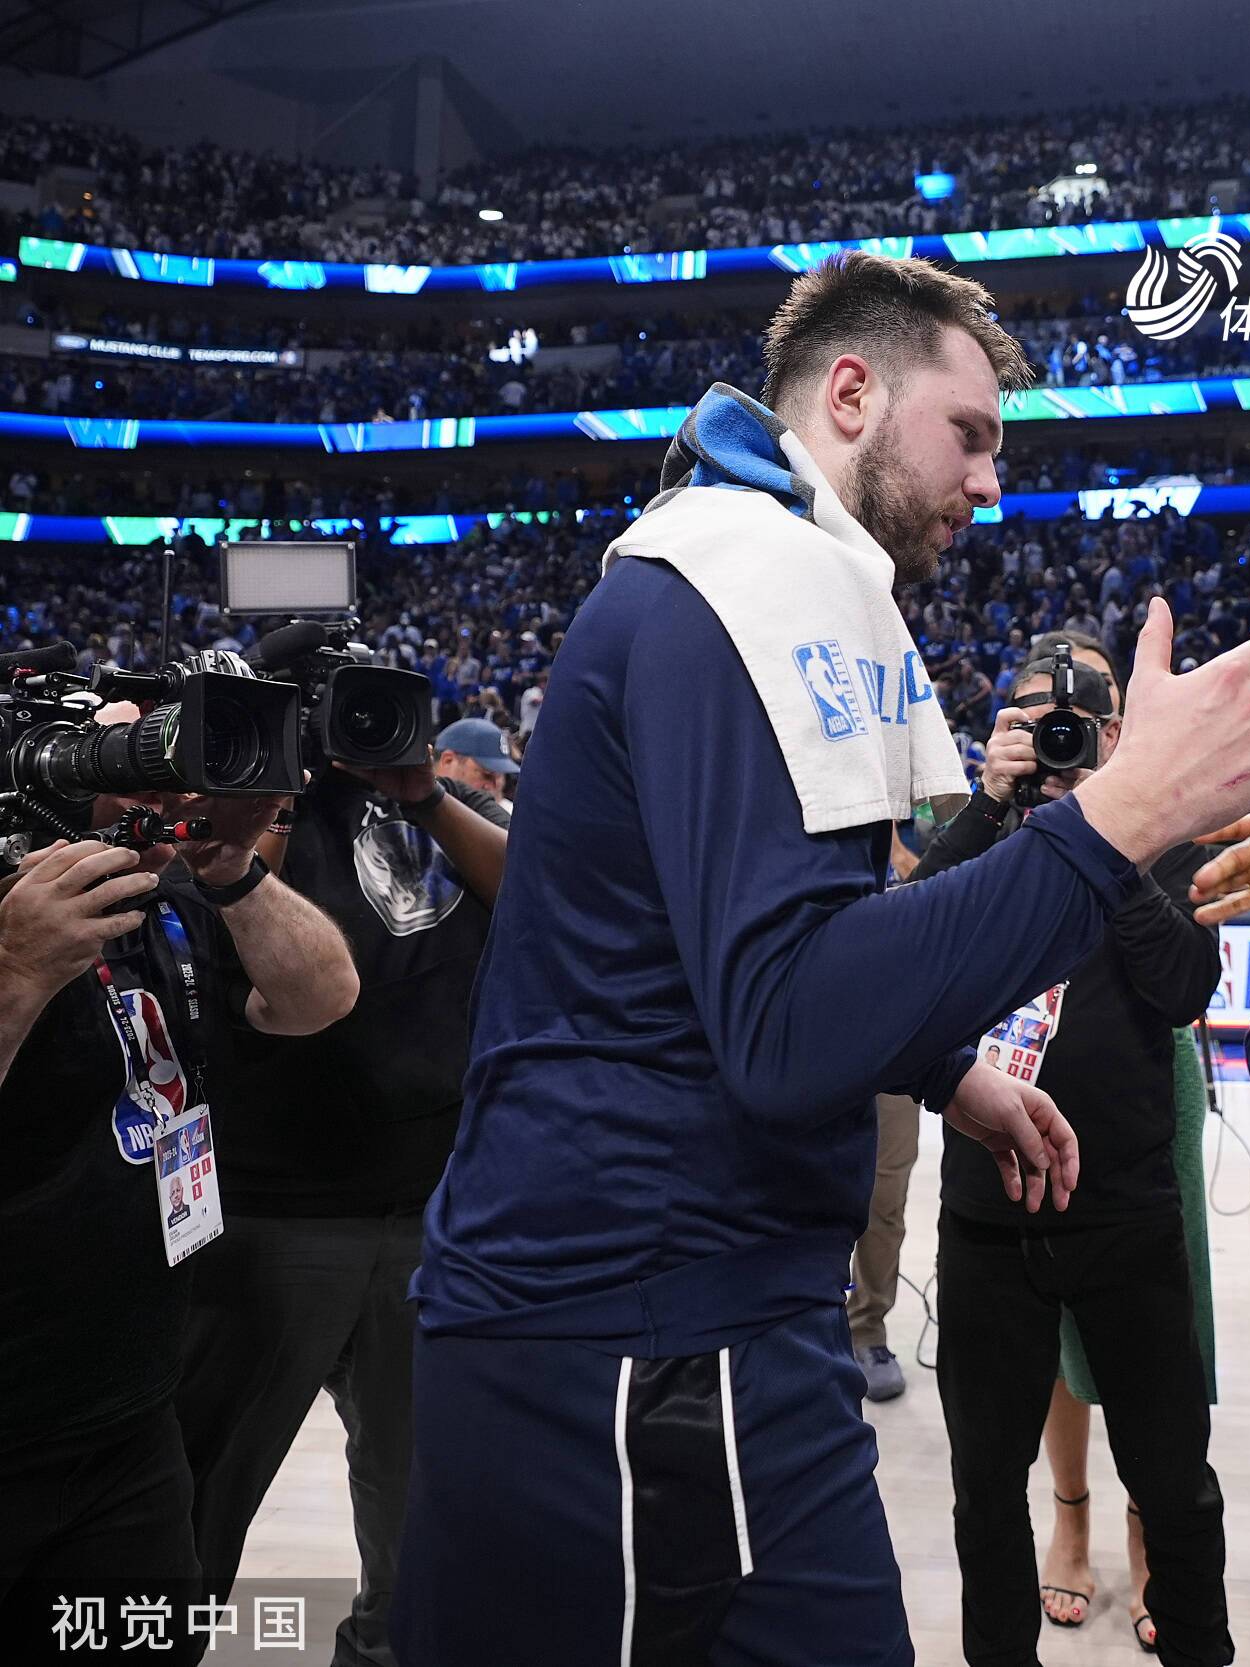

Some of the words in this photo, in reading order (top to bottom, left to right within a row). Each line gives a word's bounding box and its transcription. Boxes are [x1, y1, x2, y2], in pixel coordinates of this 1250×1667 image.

[106, 984, 121, 1006] SEASON
[120, 1016, 136, 1041] 2023-24
[126, 1123, 154, 1152] NB
